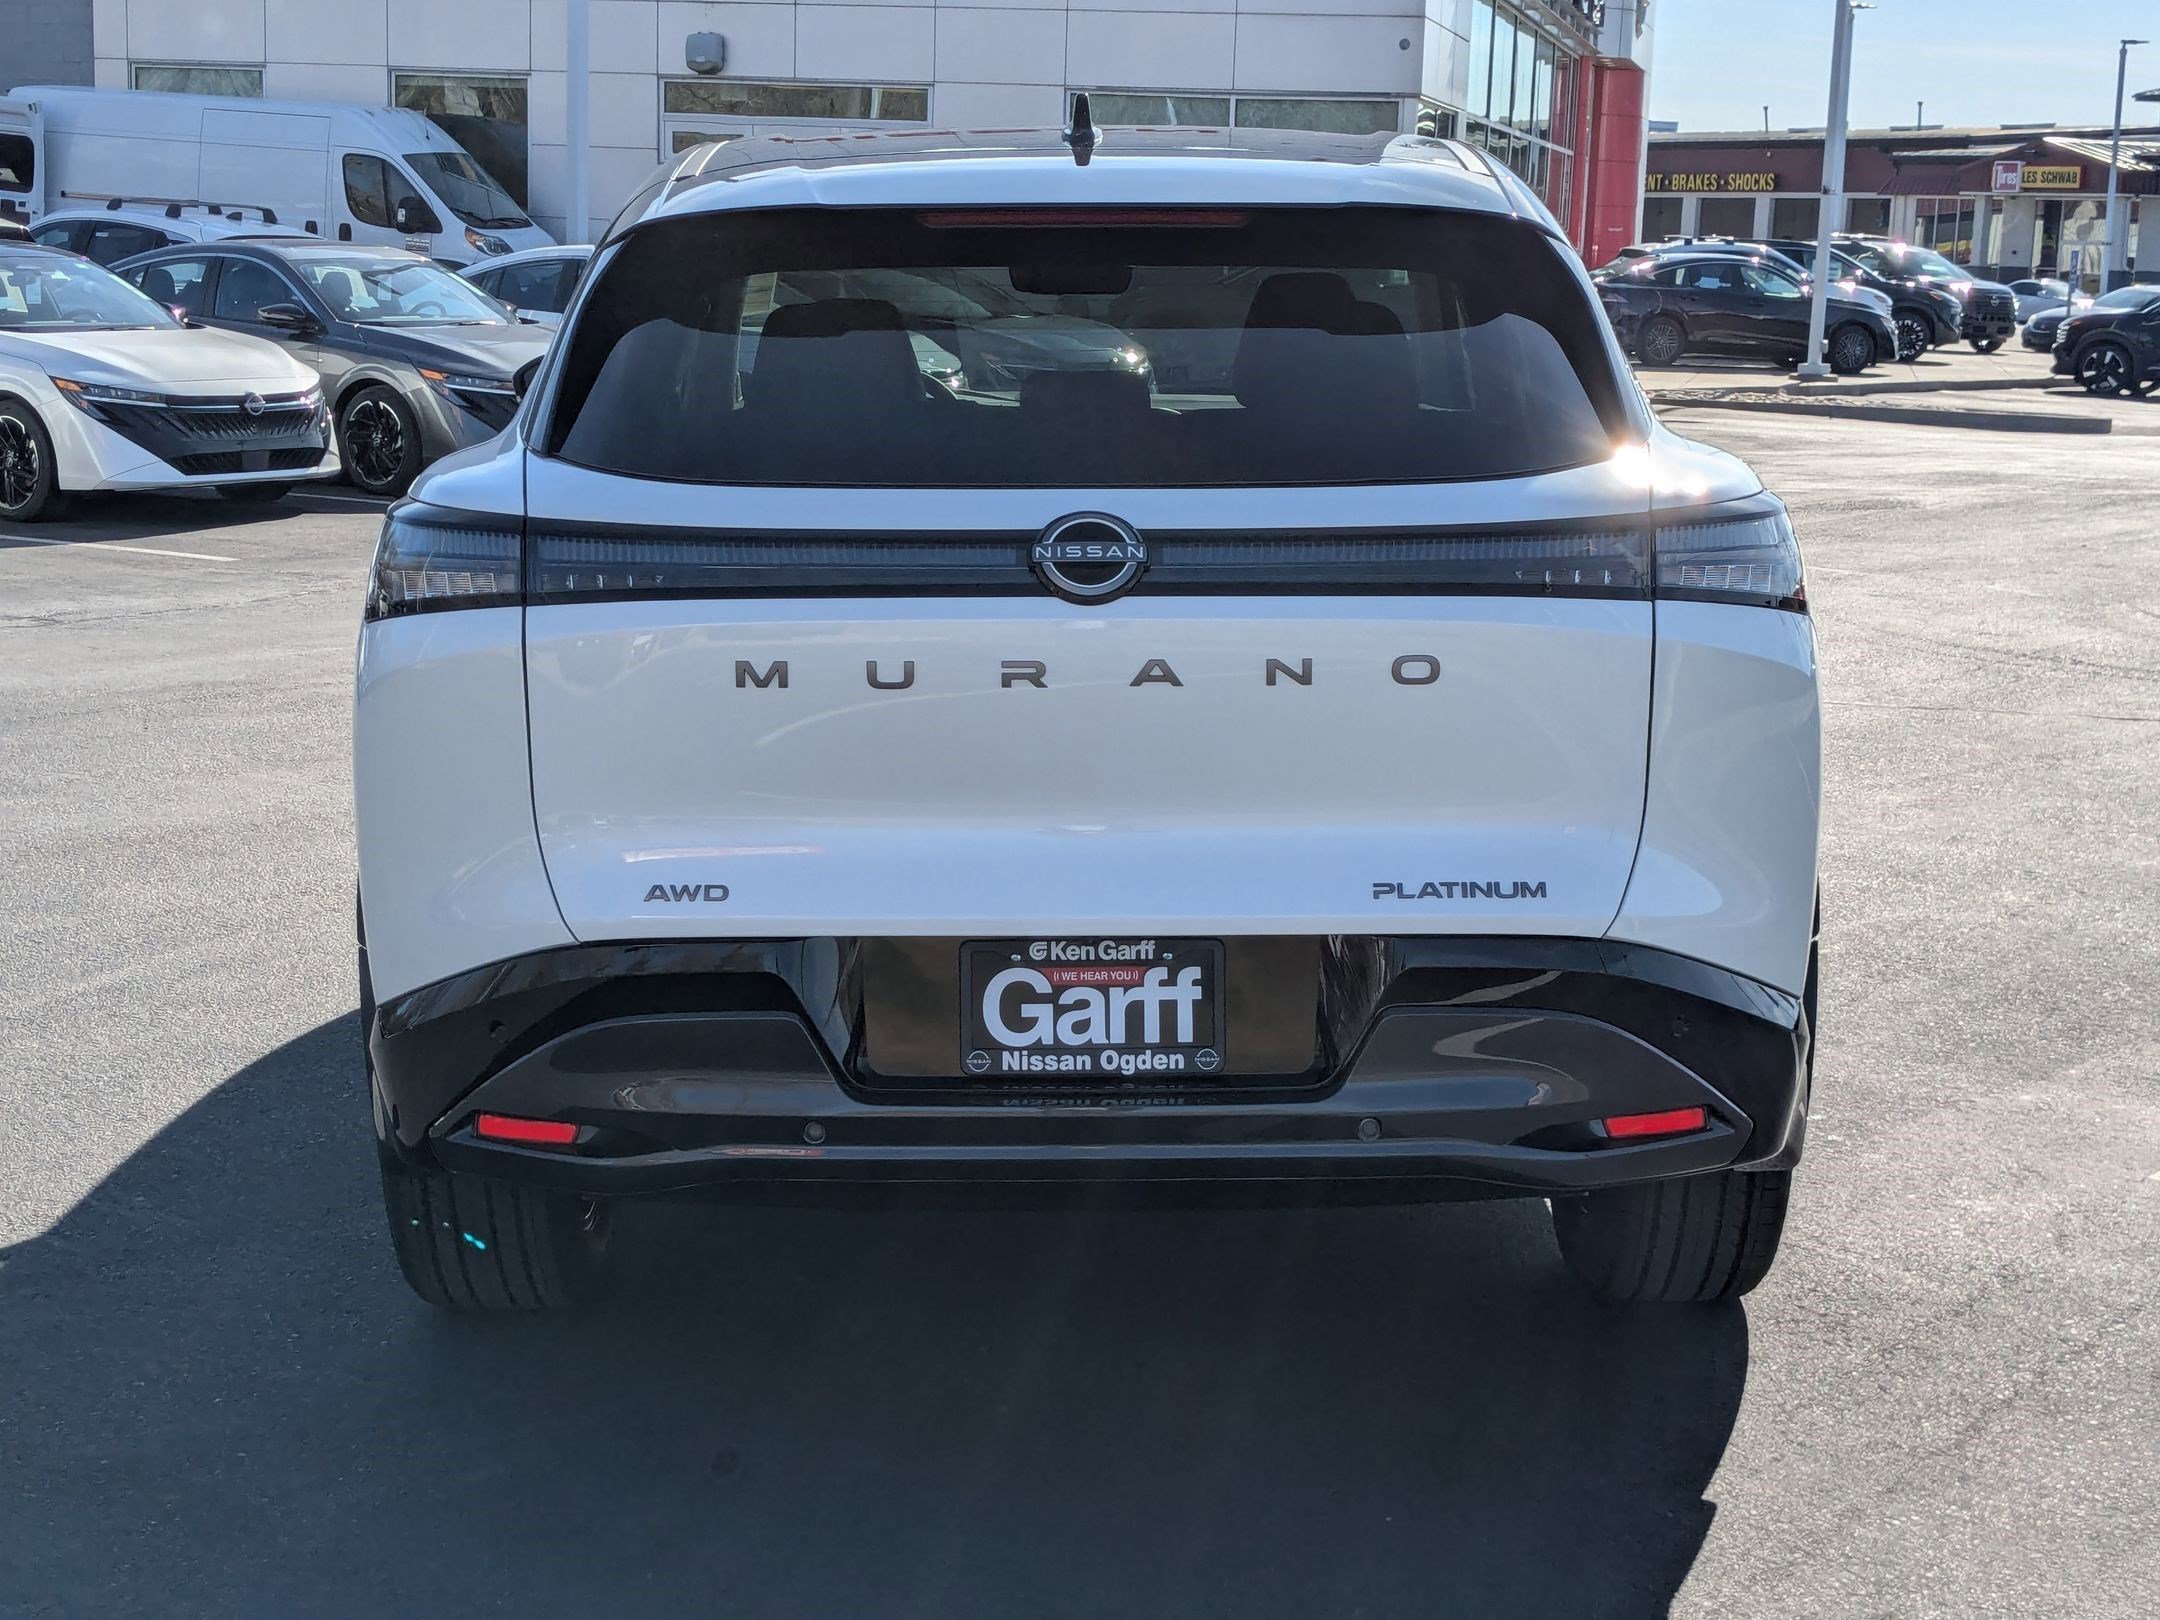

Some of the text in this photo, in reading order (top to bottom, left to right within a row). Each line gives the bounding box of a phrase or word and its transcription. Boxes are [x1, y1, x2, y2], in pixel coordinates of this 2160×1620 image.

[1671, 173, 1719, 191] BRAKES
[1728, 173, 1776, 191] SHOCKS
[2022, 170, 2078, 184] LES SCHWAB
[1035, 545, 1144, 559] NISSAN
[734, 654, 1442, 690] MURANO
[643, 884, 730, 903] AWD
[1372, 881, 1548, 900] PLATINUM
[1050, 940, 1156, 961] Ken Garff
[1061, 970, 1132, 981] WE HEAR YOU
[982, 966, 1202, 1047] Garff
[1001, 1050, 1185, 1076] Nissan Ogden
